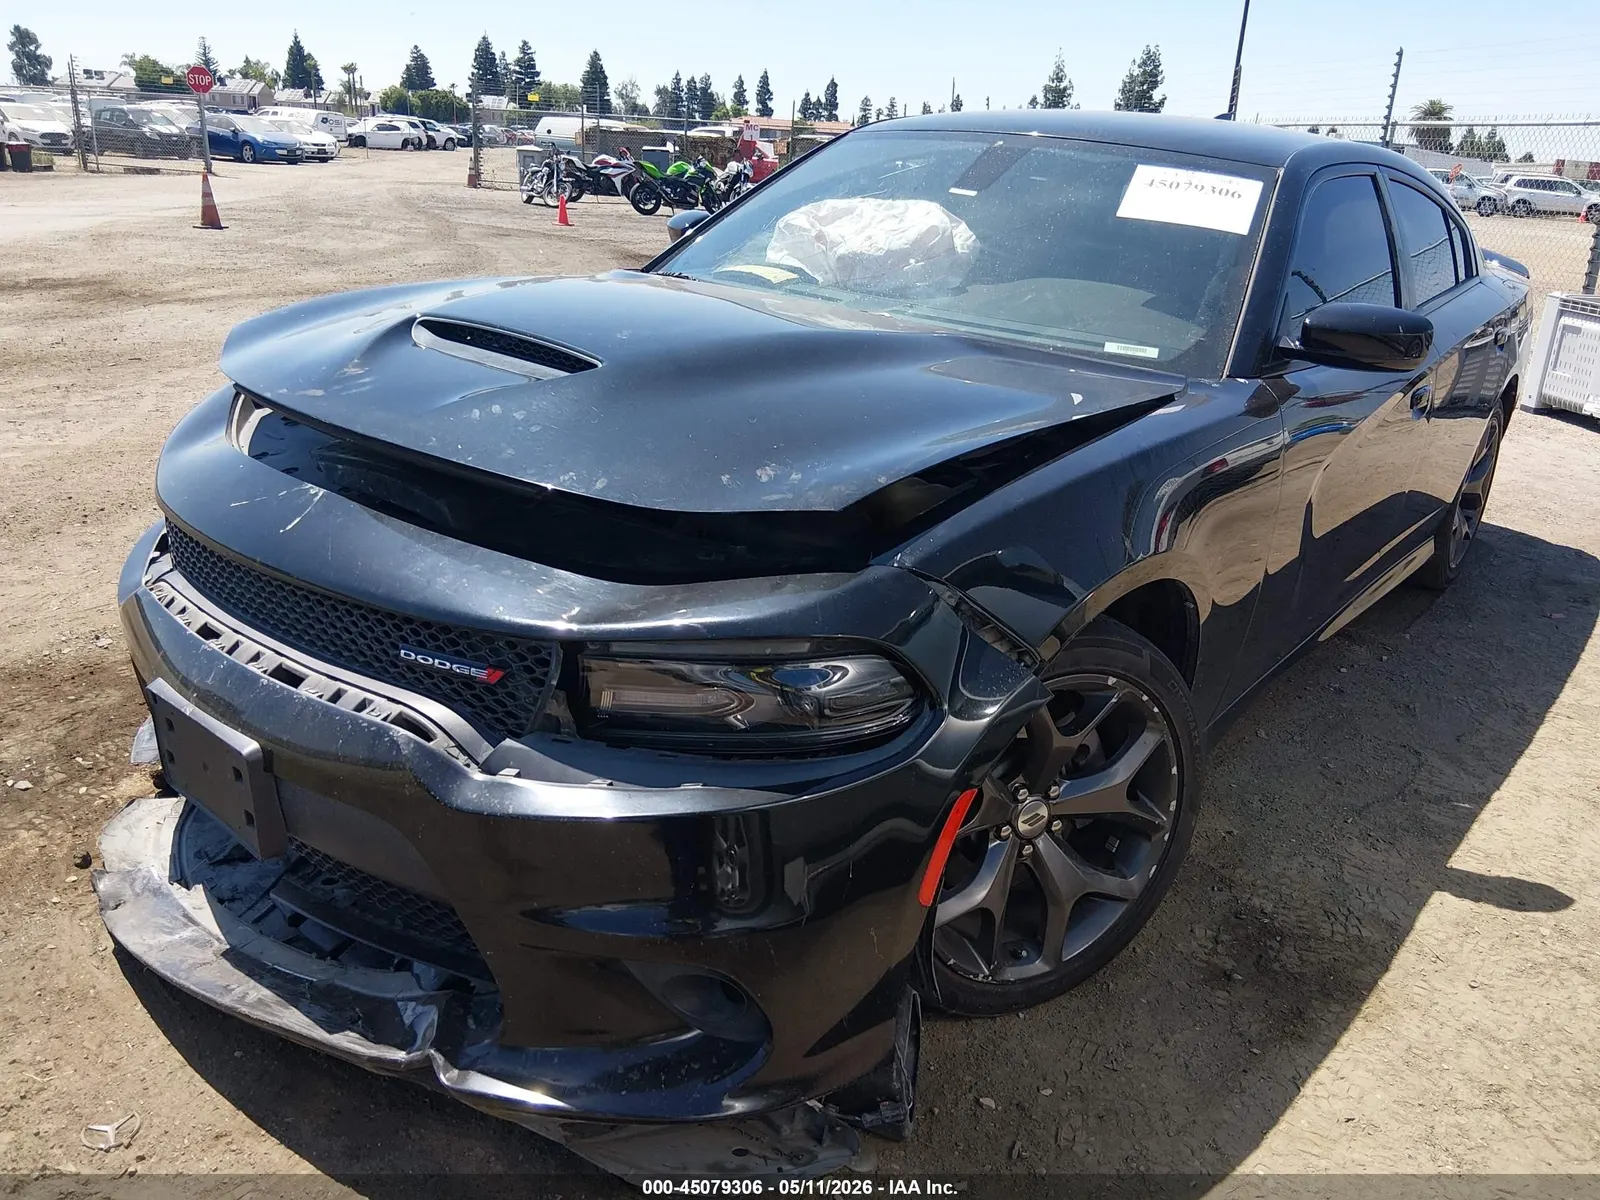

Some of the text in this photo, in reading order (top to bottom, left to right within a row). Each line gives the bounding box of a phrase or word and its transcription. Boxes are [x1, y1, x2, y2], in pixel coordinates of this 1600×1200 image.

[188, 73, 211, 86] STOP
[328, 118, 343, 126] OSI
[745, 124, 759, 132] MC
[1143, 178, 1243, 200] 45079306
[400, 649, 489, 679] DODGE
